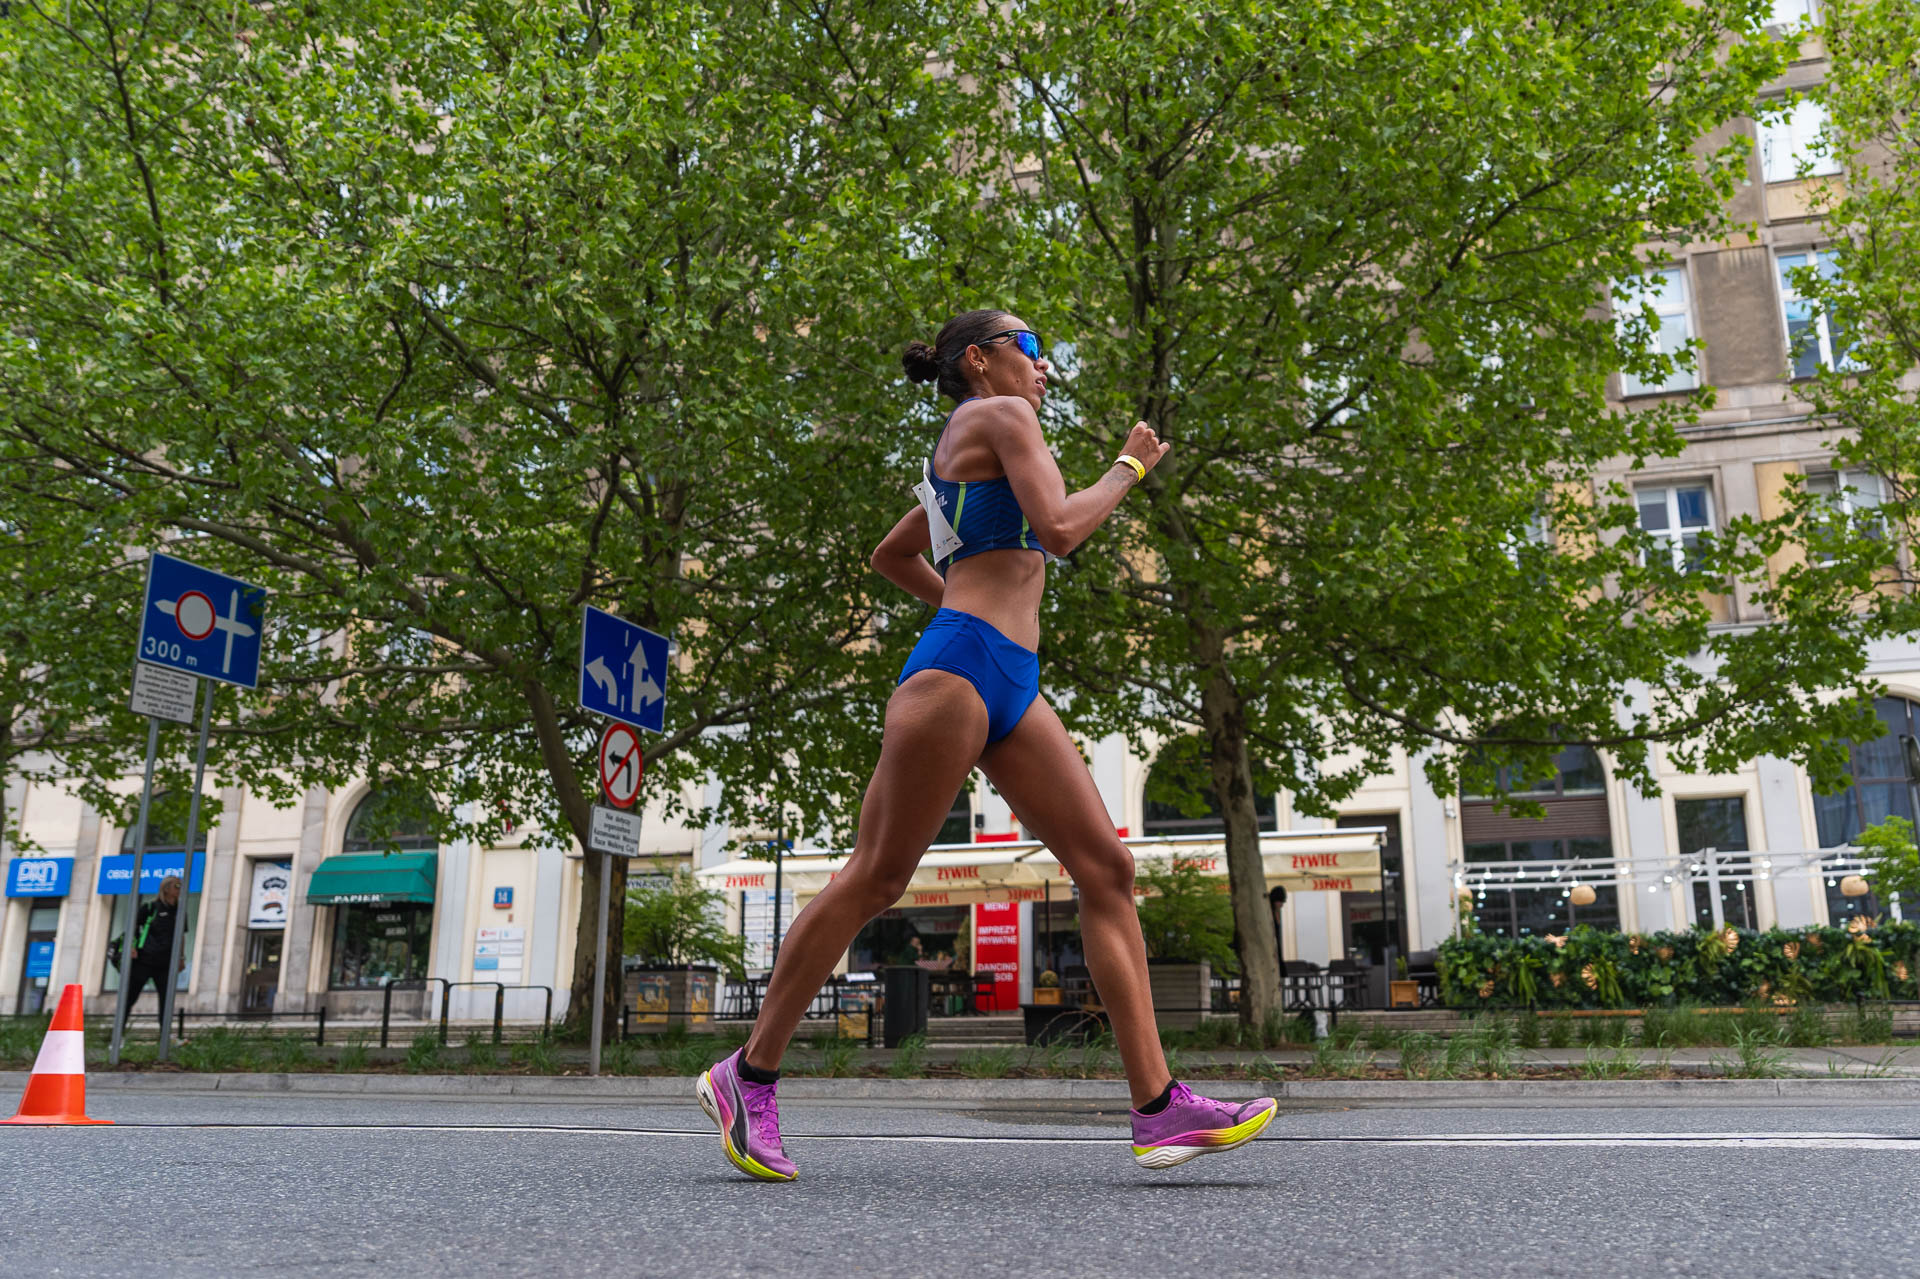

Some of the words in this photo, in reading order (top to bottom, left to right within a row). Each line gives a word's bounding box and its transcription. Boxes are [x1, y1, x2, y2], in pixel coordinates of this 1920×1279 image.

[145, 636, 181, 662] 300
[186, 655, 198, 668] m
[1292, 853, 1339, 869] ŻYWIEC
[937, 865, 979, 881] ŻYWIEC
[725, 873, 765, 888] ŻYWIEC
[498, 891, 508, 903] 14
[984, 902, 1010, 911] MENU
[977, 925, 1017, 935] IMPREZY
[977, 935, 1018, 946] PRYWATNE
[977, 962, 1018, 973] DANCING
